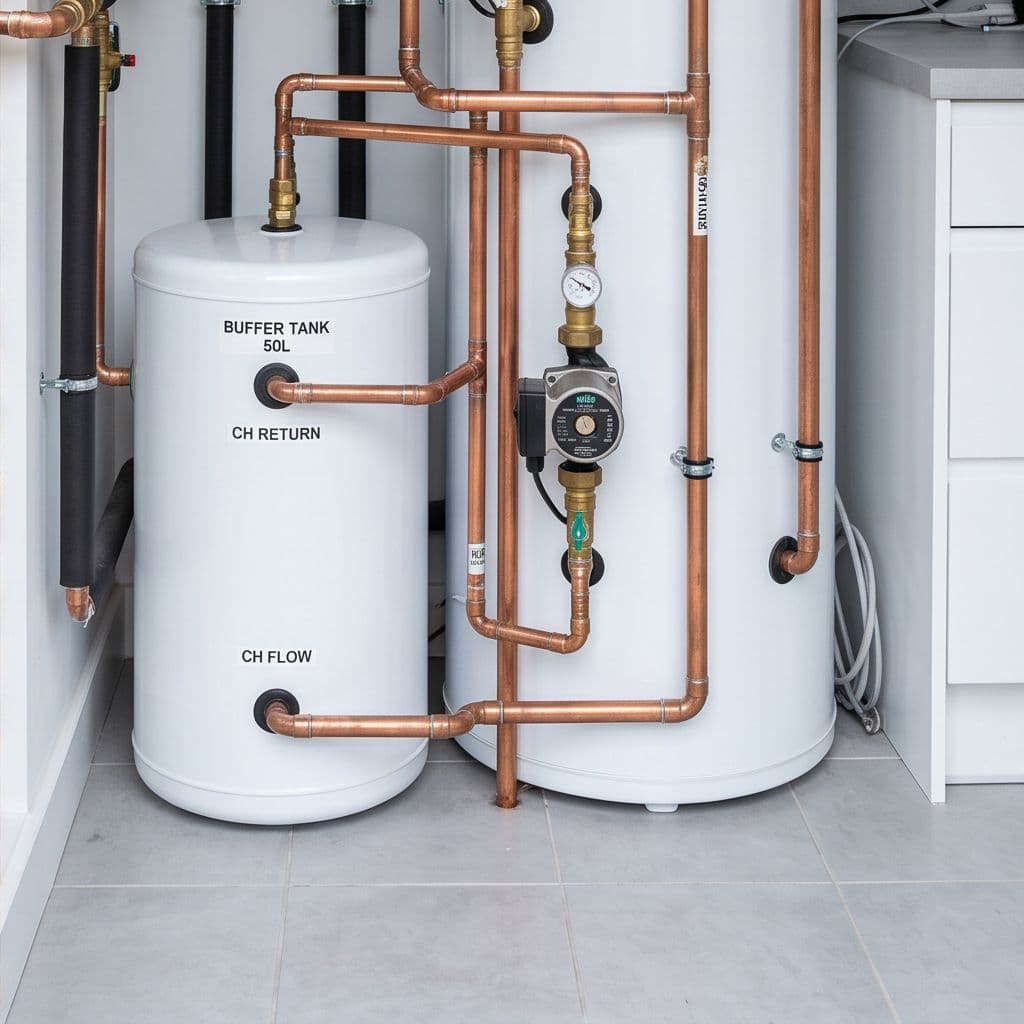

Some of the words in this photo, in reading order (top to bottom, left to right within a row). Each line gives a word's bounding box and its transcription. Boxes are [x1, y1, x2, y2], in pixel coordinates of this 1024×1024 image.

[224, 320, 284, 336] BUFFER
[288, 320, 330, 335] TANK
[263, 339, 291, 353] 50L
[232, 426, 253, 440] CH
[258, 426, 321, 441] RETURN
[241, 649, 263, 663] CH
[267, 649, 312, 664] FLOW
